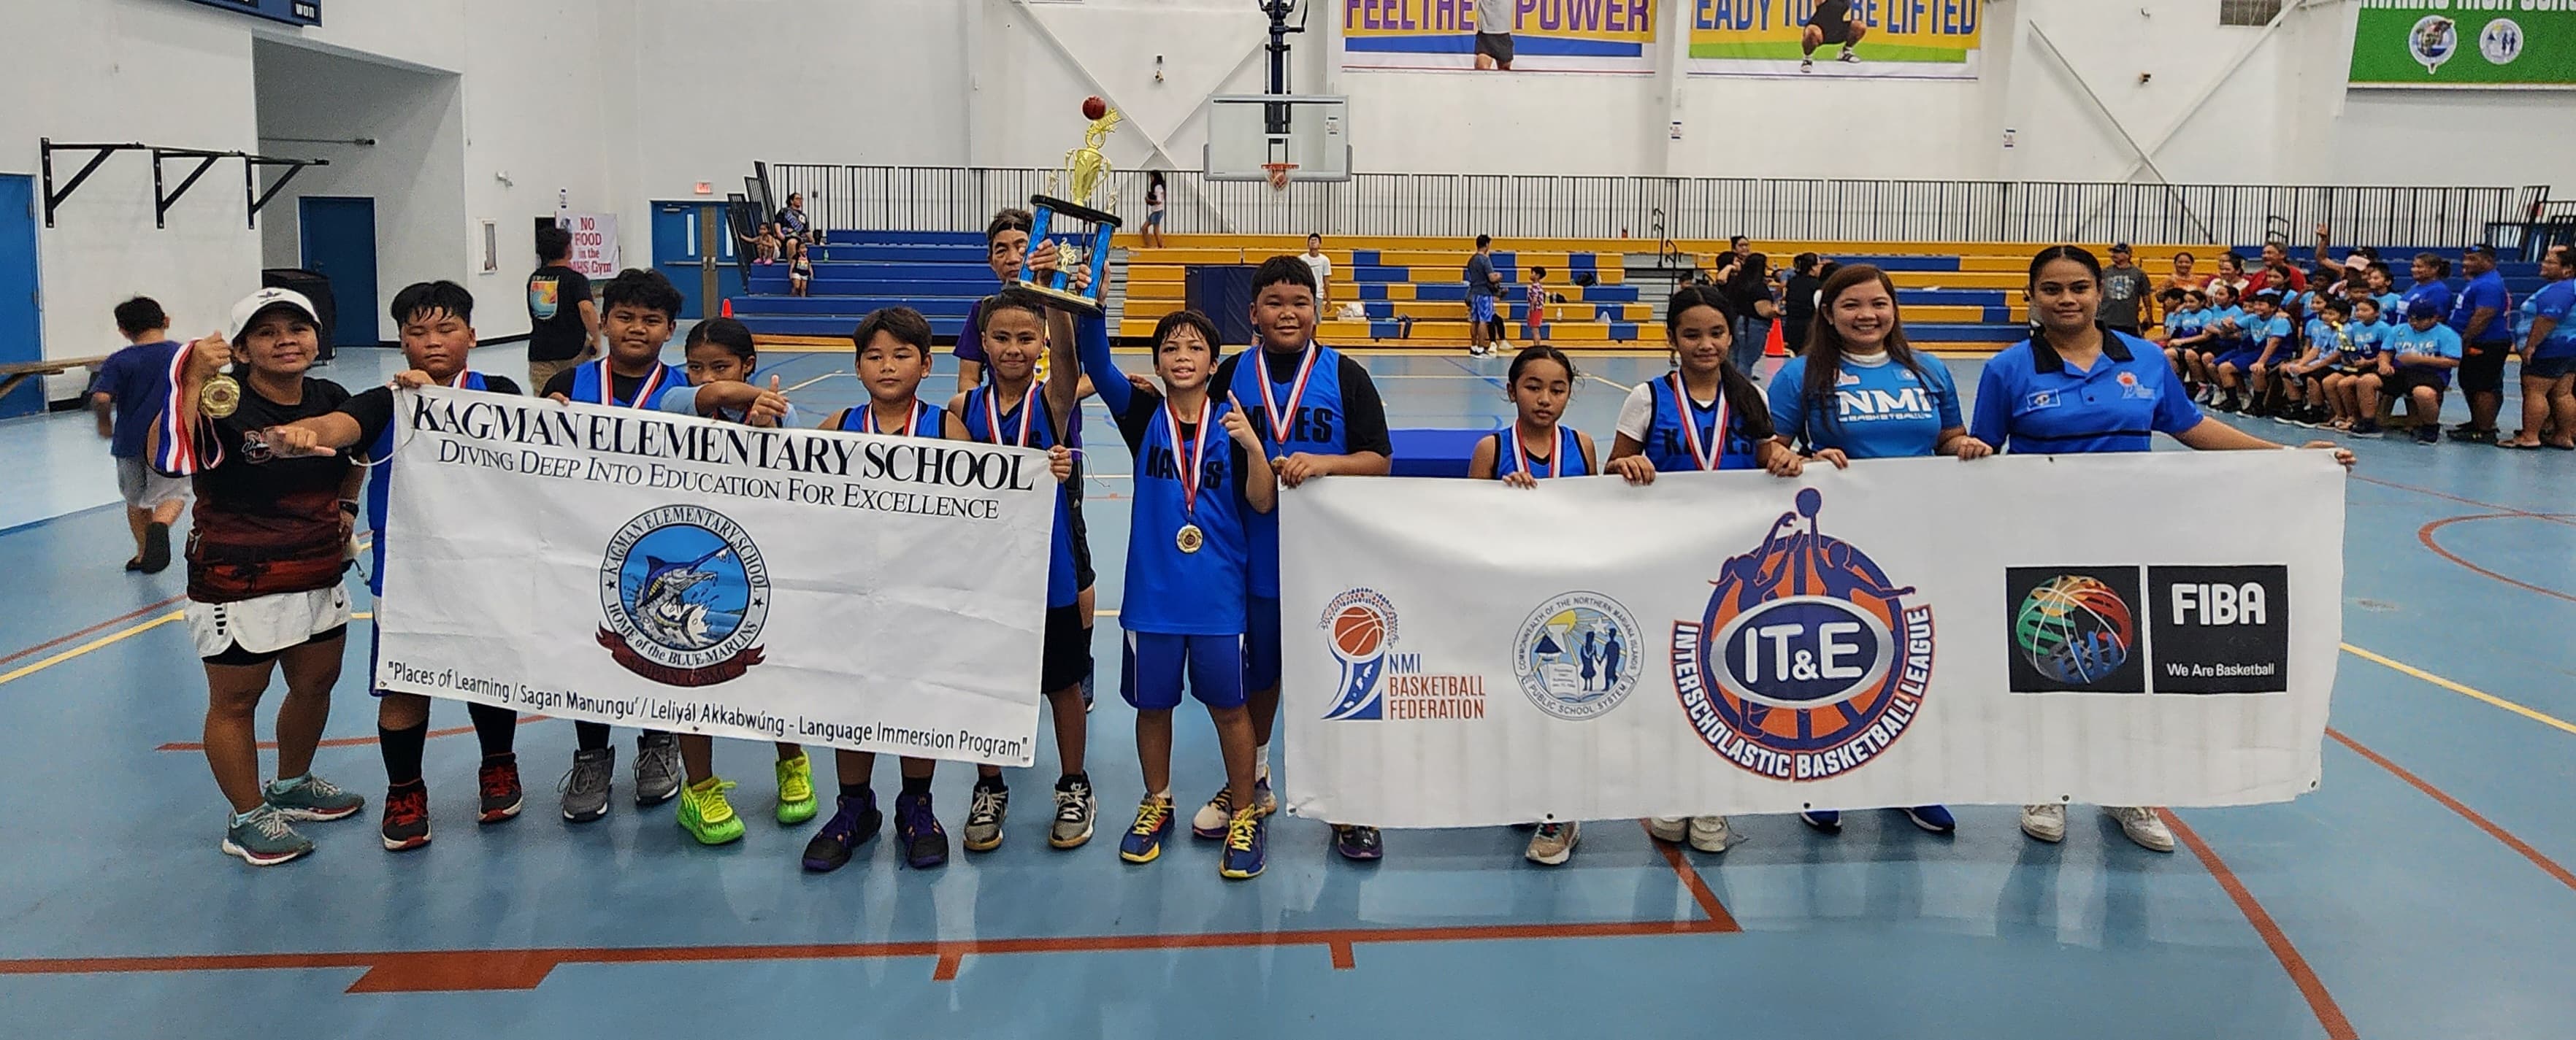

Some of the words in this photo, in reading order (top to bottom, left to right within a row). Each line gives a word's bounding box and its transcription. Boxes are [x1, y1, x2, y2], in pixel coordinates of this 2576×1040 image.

[1515, 0, 1649, 31] POWER
[1690, 0, 1771, 31] EADY
[575, 233, 602, 246] FOOD
[580, 217, 595, 231] NO
[588, 247, 599, 258] the
[591, 261, 612, 275] Gym
[1834, 388, 1933, 415] NMI
[412, 393, 581, 448] KAGMAN
[588, 414, 860, 476] ELEMENTARY
[862, 442, 1035, 491] SCHOOL
[438, 439, 514, 471] DIVING
[519, 450, 581, 479] DEEP
[585, 456, 643, 485] INTO
[648, 463, 781, 500] EDUCATION
[786, 478, 835, 505] FOR
[841, 483, 1000, 520] EXCELLENCE
[603, 520, 645, 575] KAGMAN
[645, 507, 739, 541] ELEMENTARY
[735, 536, 767, 593] SCHOOL
[2171, 582, 2266, 625] FIBA
[607, 602, 637, 644] HOME
[635, 636, 648, 651] of
[648, 646, 667, 660] the
[668, 651, 705, 666] BLUE
[705, 621, 759, 663] MARLINS
[1518, 613, 1547, 671] COMMONWEALTH
[1545, 606, 1555, 615] OF
[1556, 599, 1571, 609] THE
[1573, 596, 1612, 612] NORTHERN
[1612, 609, 1636, 638] MARIANA
[1389, 653, 1421, 674] NMI
[1744, 622, 1863, 684] IT&E
[2166, 663, 2190, 677] We
[2192, 663, 2215, 677] Are
[2215, 662, 2275, 677] Basketball
[1389, 675, 1486, 696] BASKETBALL
[1528, 684, 1557, 710] PUBLIC
[1558, 705, 1595, 715] SCHOOL
[1598, 685, 1627, 710] SYSTEM
[1674, 624, 1792, 777] INTERSCHOLASTIC
[1796, 697, 1916, 778] BASKETBALL
[1901, 608, 1932, 697] LEAGUE
[388, 660, 434, 686] "Places
[437, 669, 453, 687] of
[455, 673, 510, 703] Learning
[521, 685, 562, 710] Sagan
[700, 704, 784, 737] Akkabwúng
[799, 715, 873, 744] Language
[877, 722, 954, 749] Immersion
[959, 731, 1028, 758] Program"
[1389, 698, 1484, 720] FEDERATION
